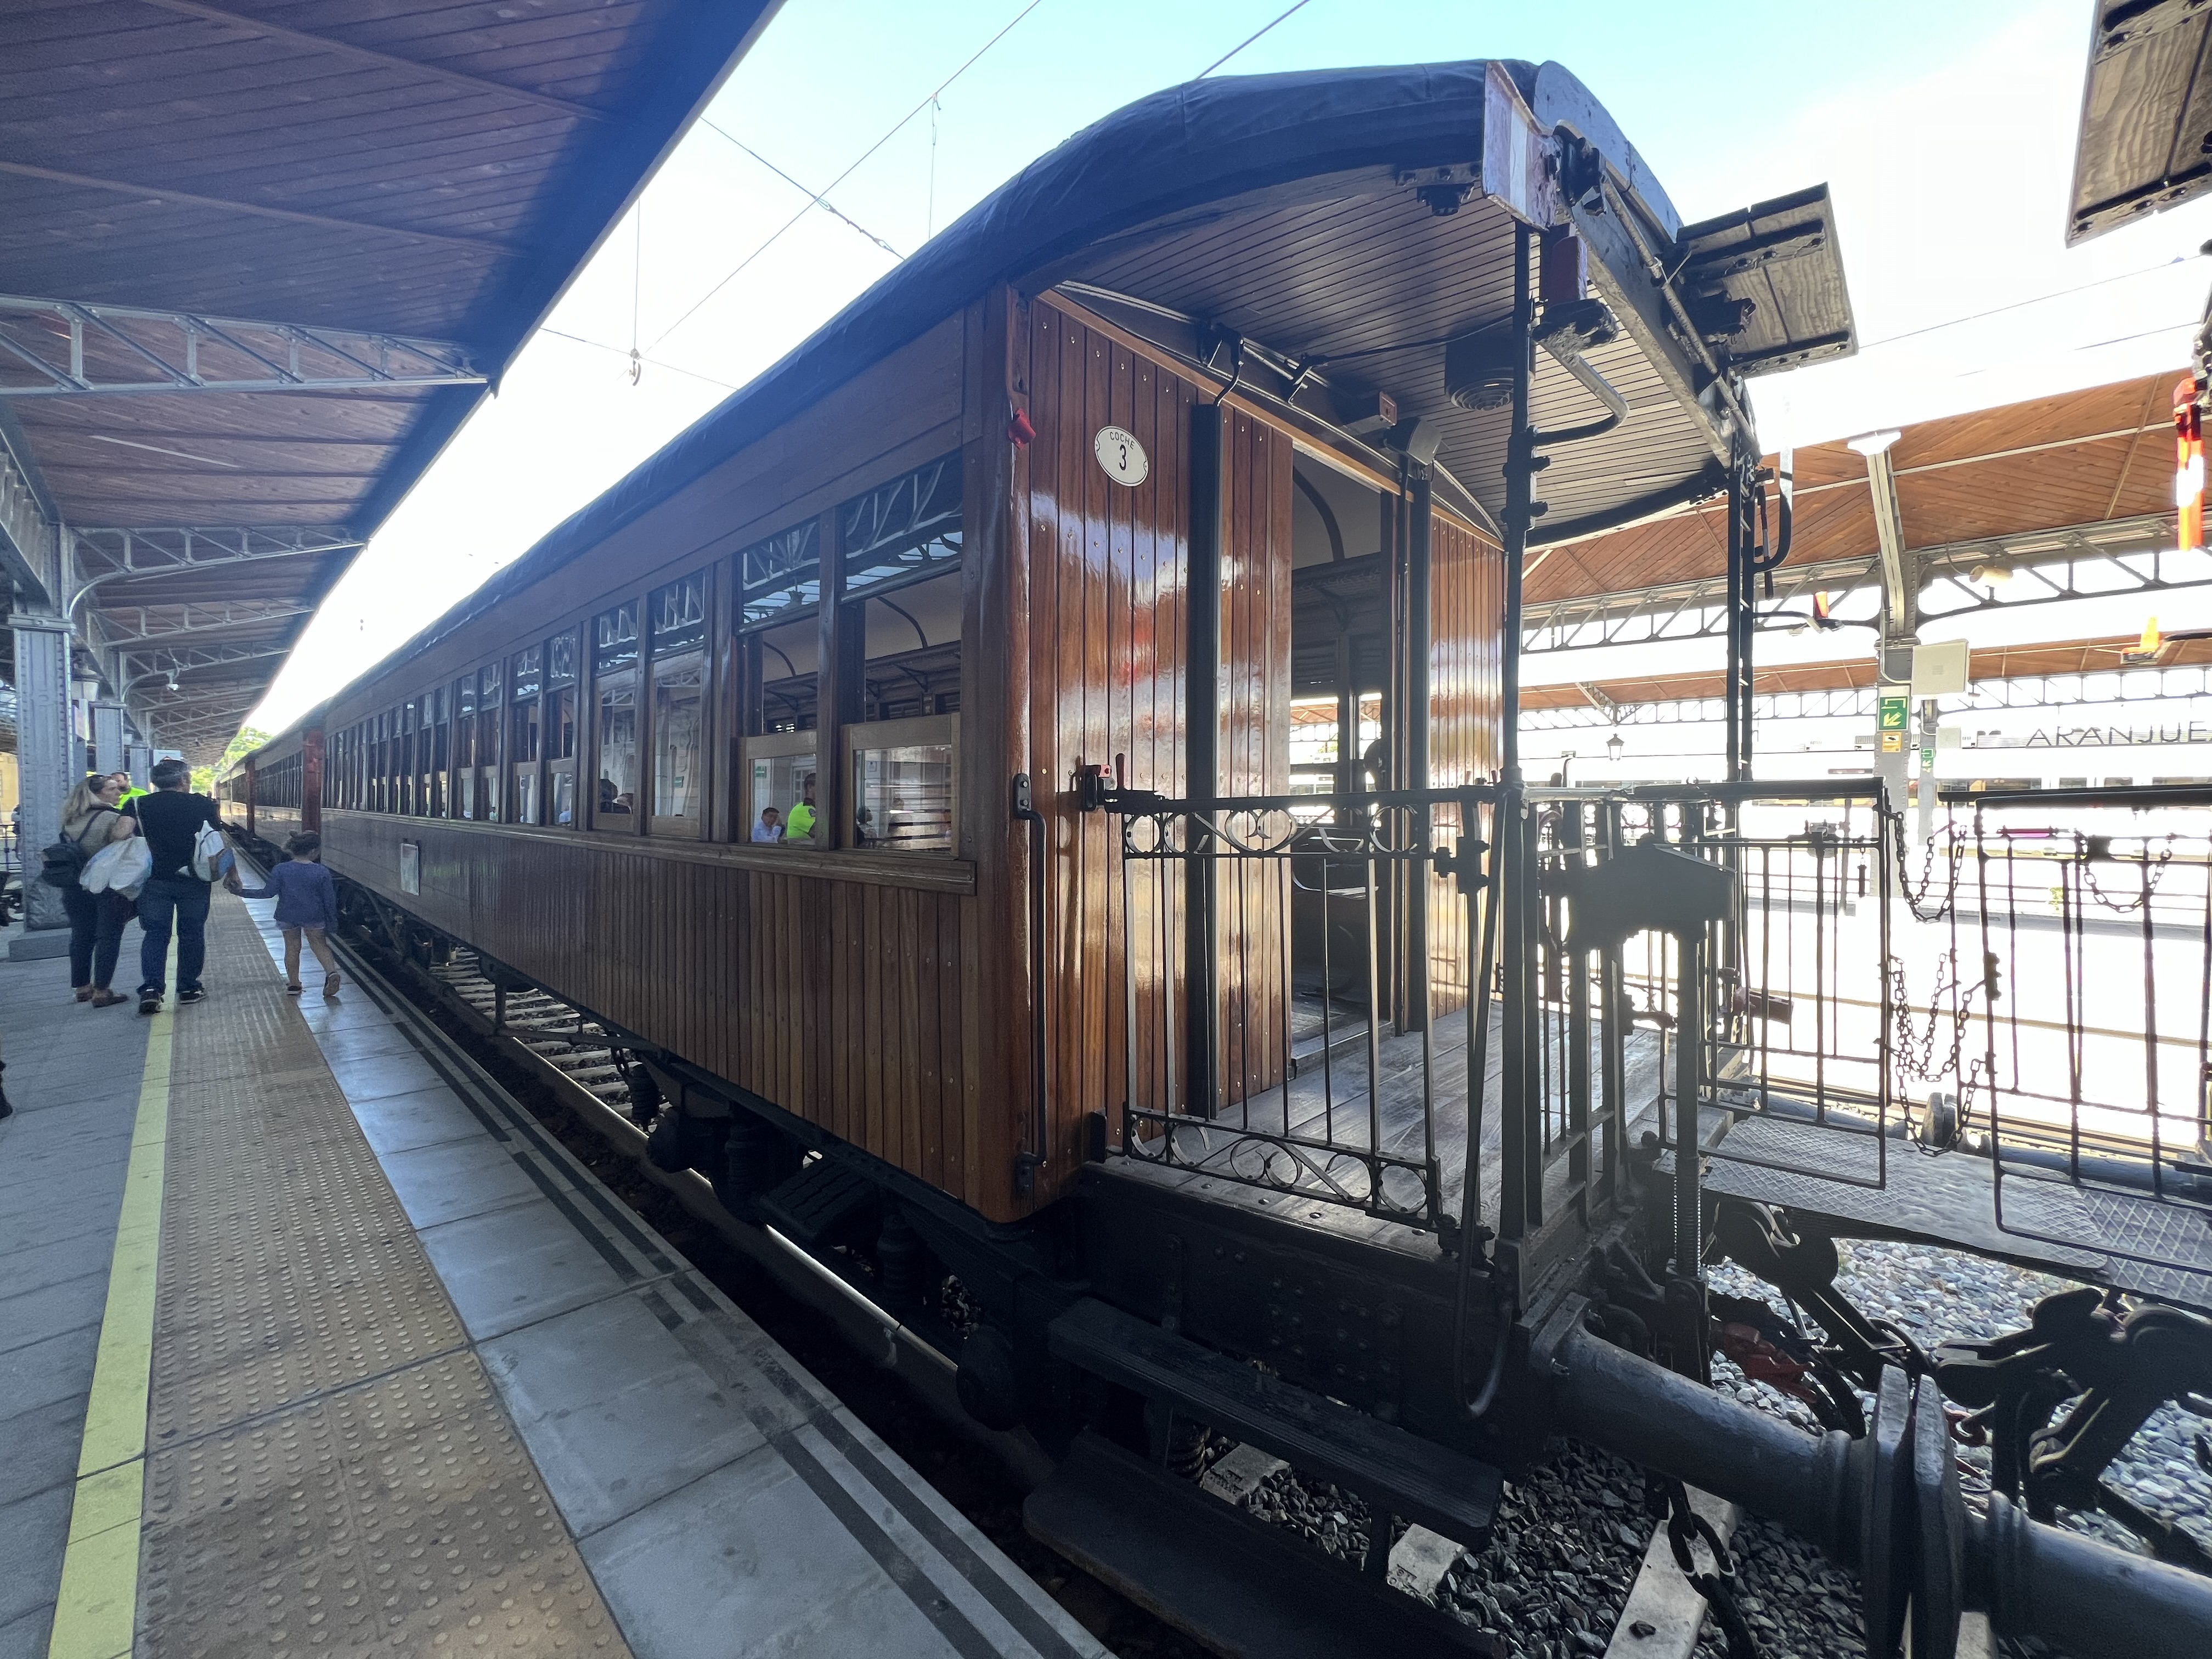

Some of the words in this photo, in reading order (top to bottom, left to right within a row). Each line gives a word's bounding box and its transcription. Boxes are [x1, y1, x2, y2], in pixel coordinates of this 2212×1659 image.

[1109, 431, 1135, 450] COCHE
[1119, 444, 1126, 471] 3
[2025, 721, 2212, 748] ARANJUE
